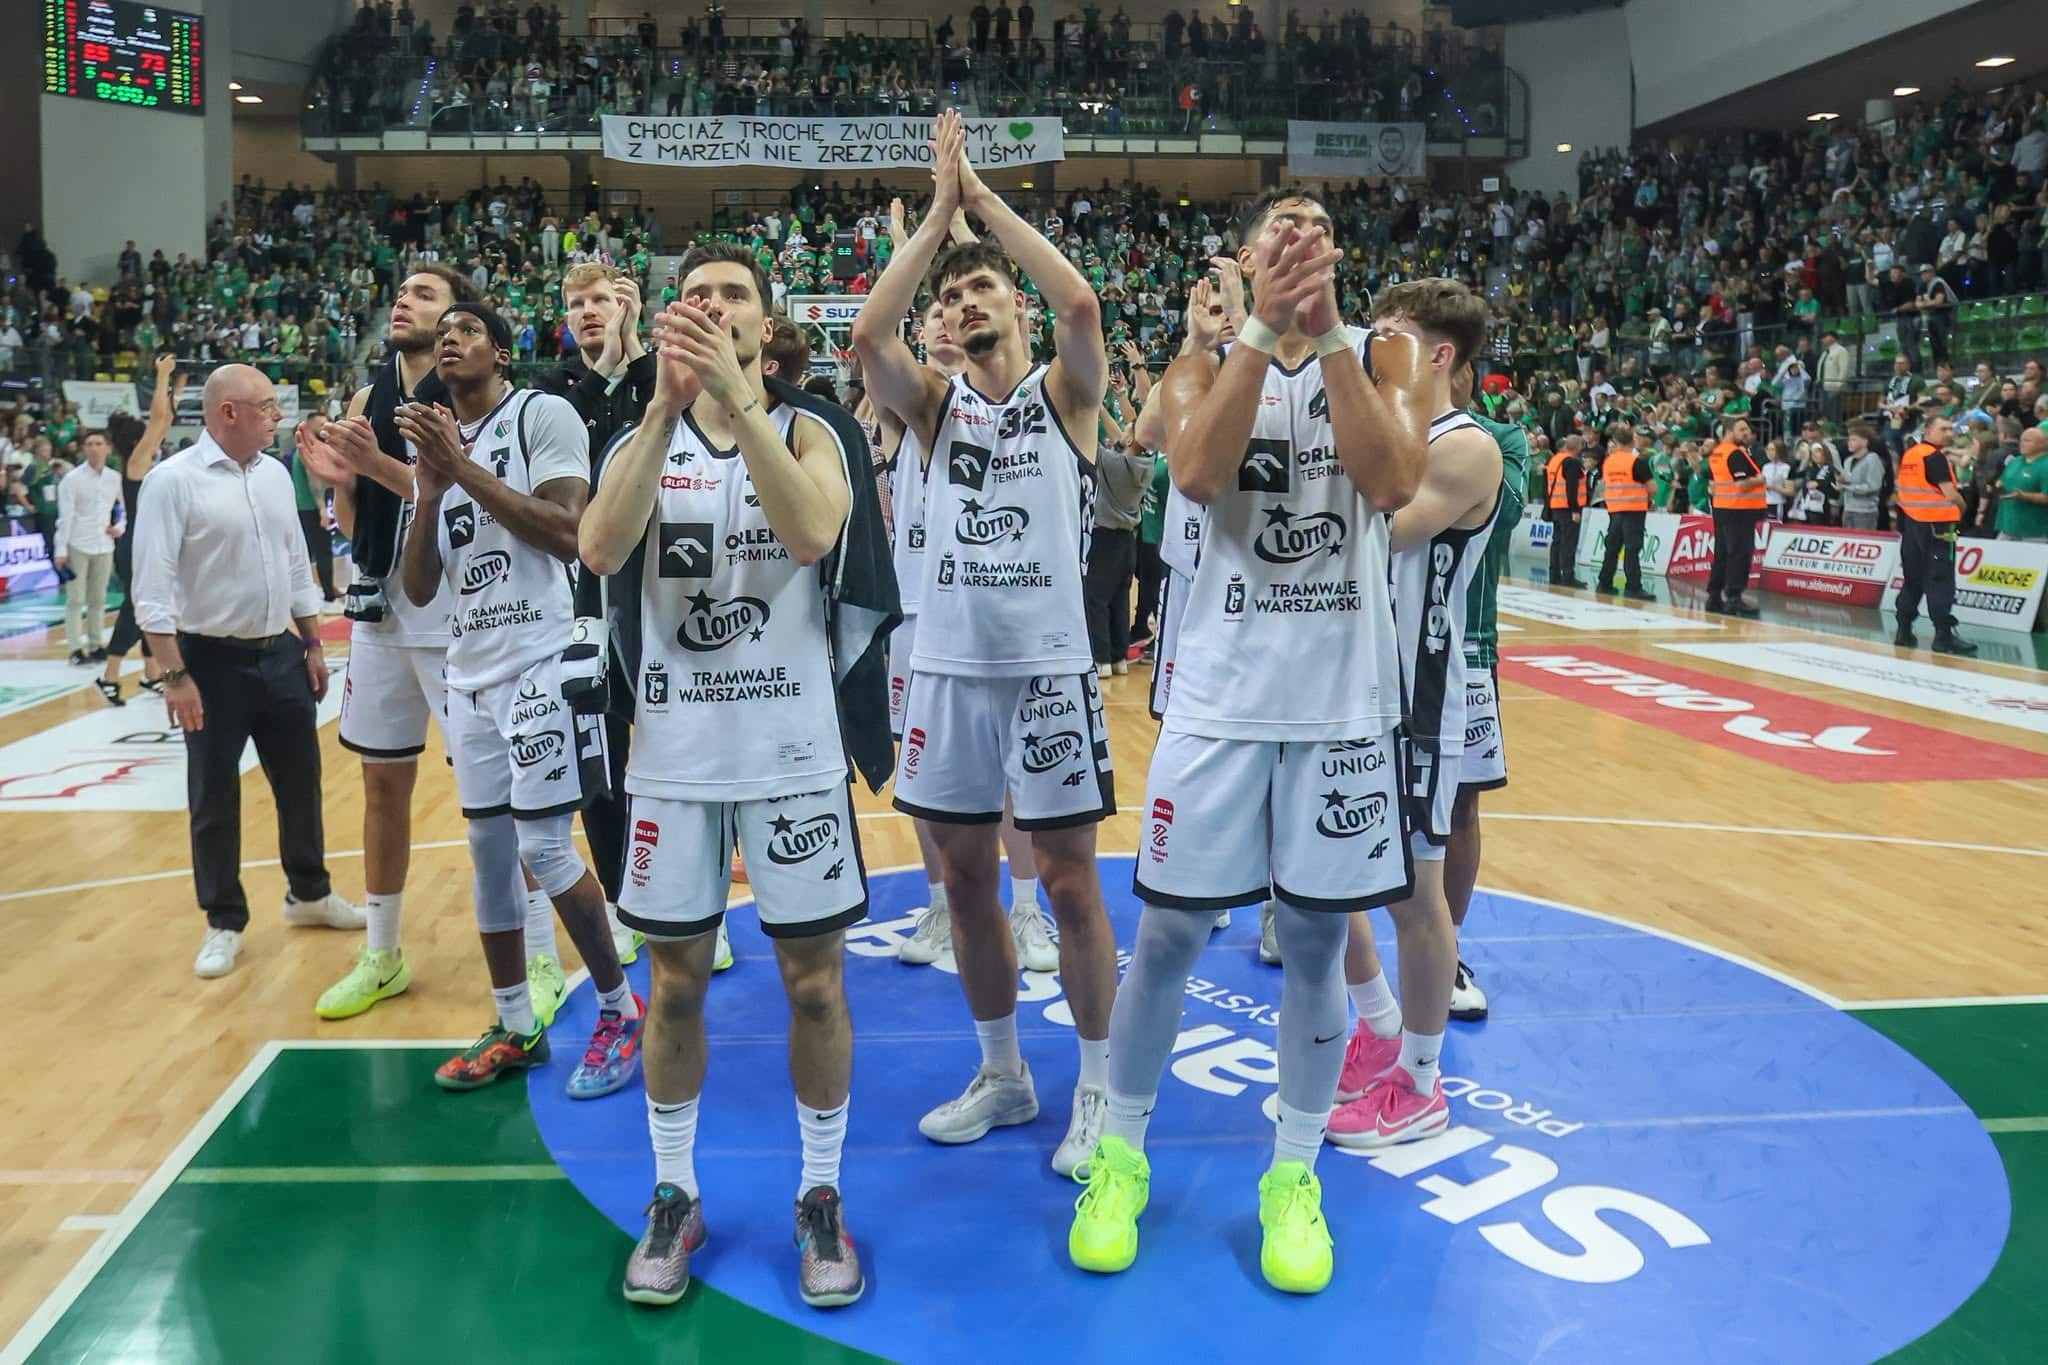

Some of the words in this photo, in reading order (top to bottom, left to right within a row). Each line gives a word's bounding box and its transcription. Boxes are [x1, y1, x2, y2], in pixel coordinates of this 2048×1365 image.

[628, 119, 724, 139] CHOCIAŻ
[738, 121, 824, 144] TROCHĘ
[840, 122, 998, 142] ZWOLNILMY
[628, 142, 642, 158] Z
[657, 139, 750, 161] MARZEŃ
[764, 145, 802, 162] NIE
[826, 307, 857, 319] SUZ
[999, 404, 1047, 439] 32
[991, 451, 1040, 470] ORLEN
[991, 466, 1043, 484] TERMIKA
[966, 513, 1014, 539] LOTTO
[1274, 521, 1331, 554] LOTTO
[1785, 537, 1834, 555] ALDE
[1831, 542, 1882, 560] MED
[464, 557, 503, 588] LOTTO
[963, 561, 1041, 575] TRAMWAJE
[1269, 580, 1358, 598] TRAMWAJE
[697, 605, 752, 642] LOTTO
[692, 666, 787, 687] TRAMWAJE
[679, 682, 801, 703] WARSZAWSKIE
[511, 700, 560, 725] UNIQA
[1020, 699, 1078, 723] UNIQA
[1465, 721, 1492, 742] OTTO
[518, 737, 555, 762] LOTTO
[1031, 736, 1073, 767] LOTTO
[1321, 751, 1387, 778] UNIQA
[1332, 799, 1381, 831] LOTTO
[781, 821, 832, 856] LOTTO
[1439, 1075, 1584, 1138] PROD
